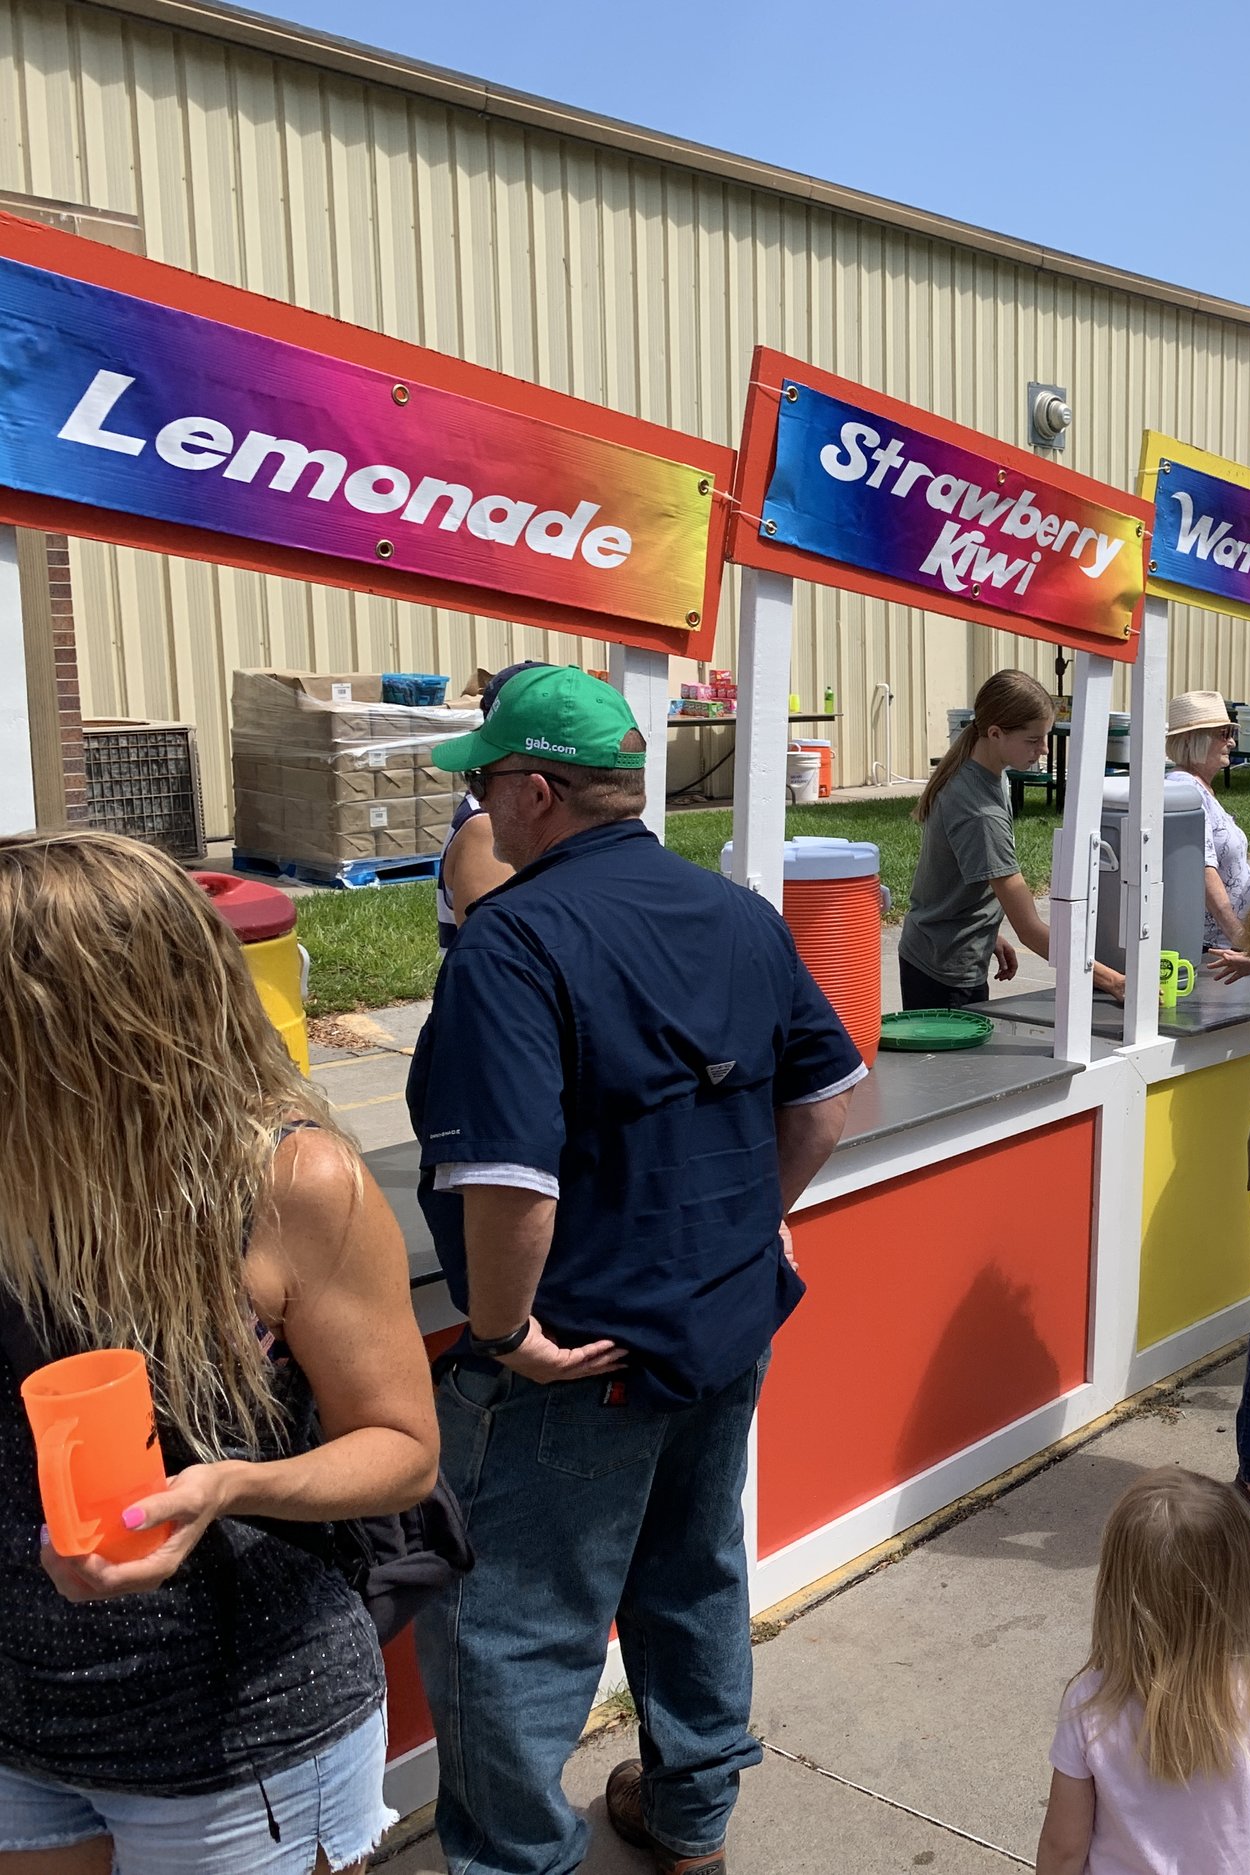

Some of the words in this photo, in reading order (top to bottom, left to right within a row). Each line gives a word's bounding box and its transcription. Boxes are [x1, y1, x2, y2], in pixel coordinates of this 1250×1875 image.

[57, 368, 634, 570] Lemonade
[819, 421, 1125, 579] Strawberry
[920, 521, 1043, 597] Kiwi
[525, 736, 577, 756] gab.com
